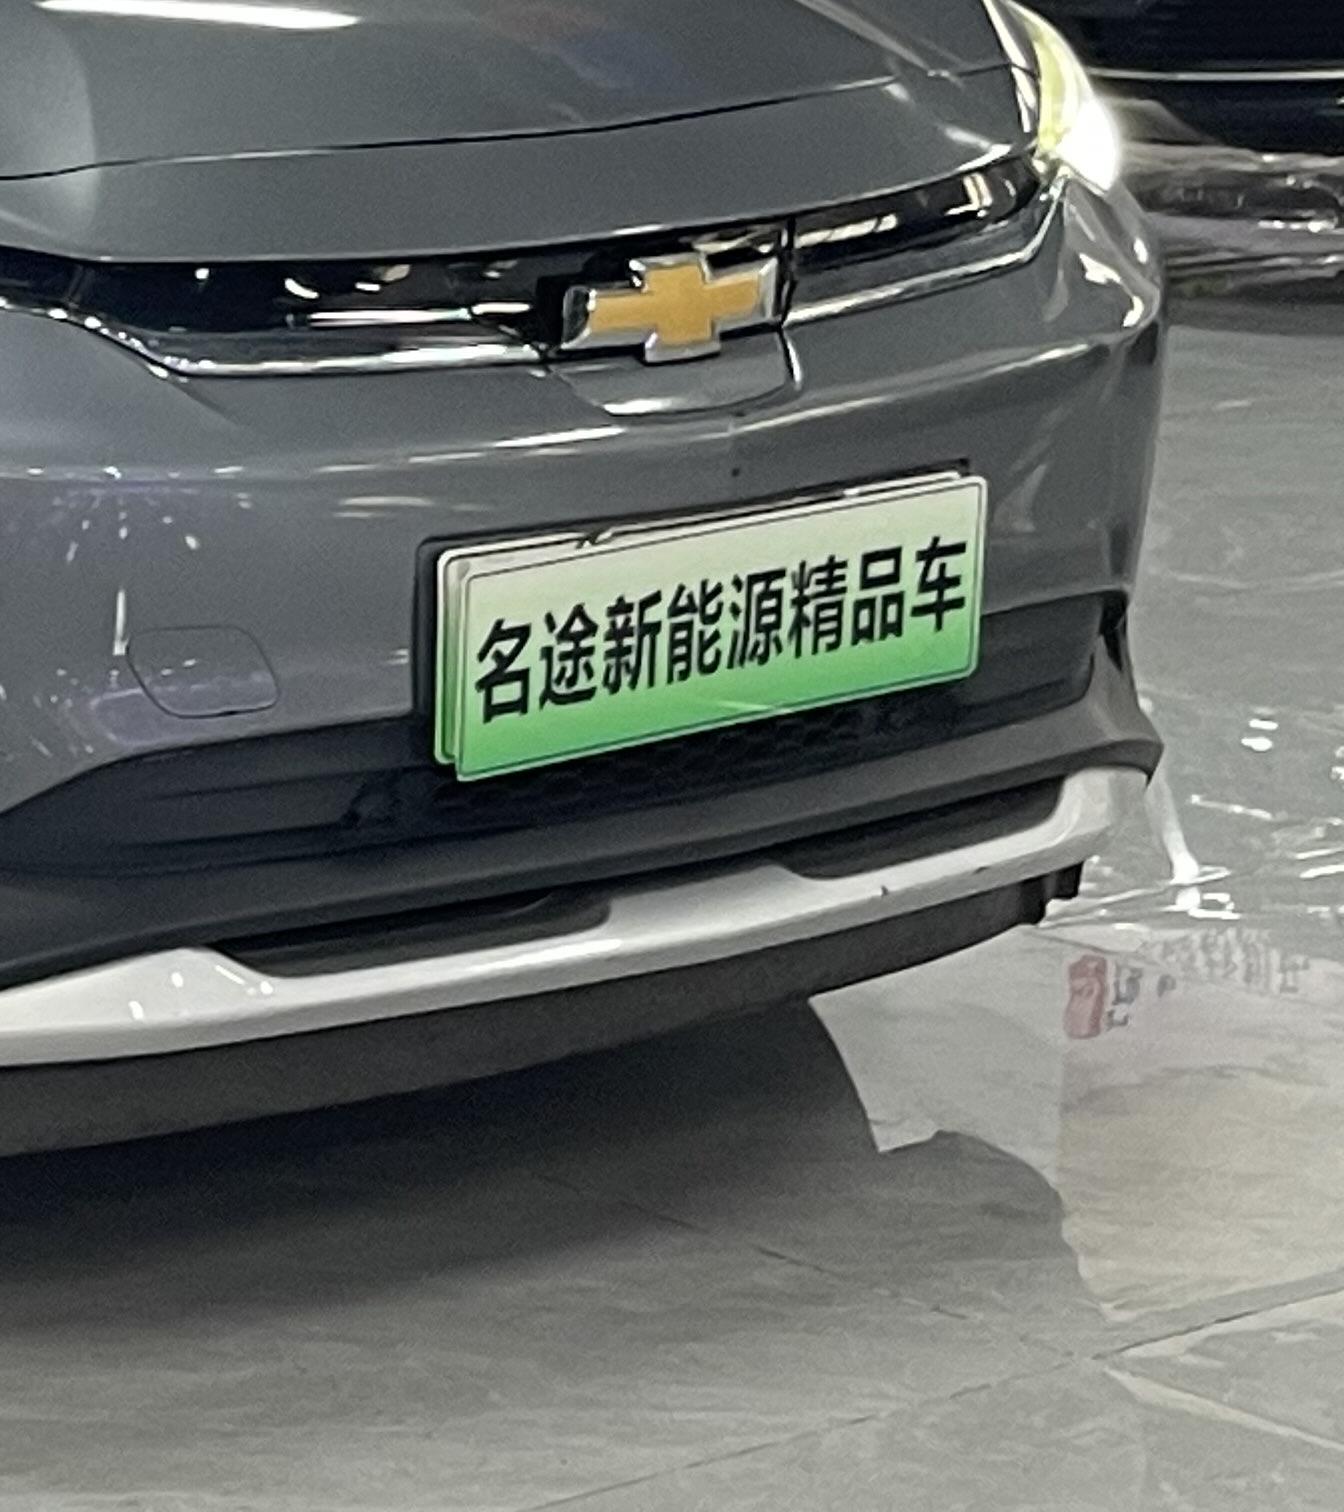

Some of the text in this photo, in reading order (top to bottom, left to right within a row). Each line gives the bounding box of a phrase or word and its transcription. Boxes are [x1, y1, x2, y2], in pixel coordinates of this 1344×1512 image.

[474, 536, 968, 725] 名途新能源精品车
